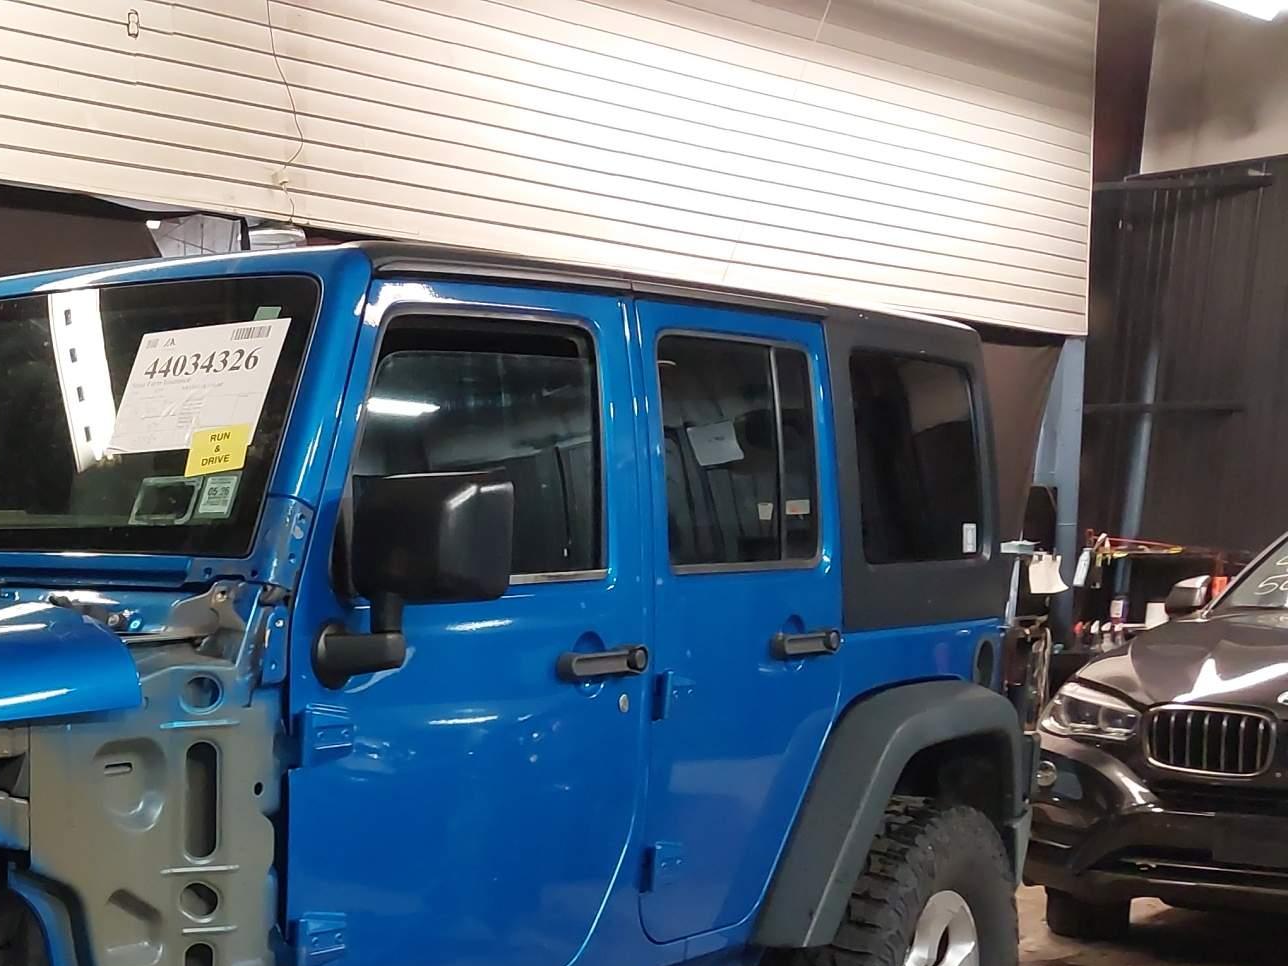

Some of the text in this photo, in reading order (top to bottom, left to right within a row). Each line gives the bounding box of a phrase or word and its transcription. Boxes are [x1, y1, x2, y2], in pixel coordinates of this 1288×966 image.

[144, 345, 264, 379] 44034326
[210, 432, 231, 442] RUN
[214, 445, 220, 453] &
[201, 454, 230, 466] DRIVE
